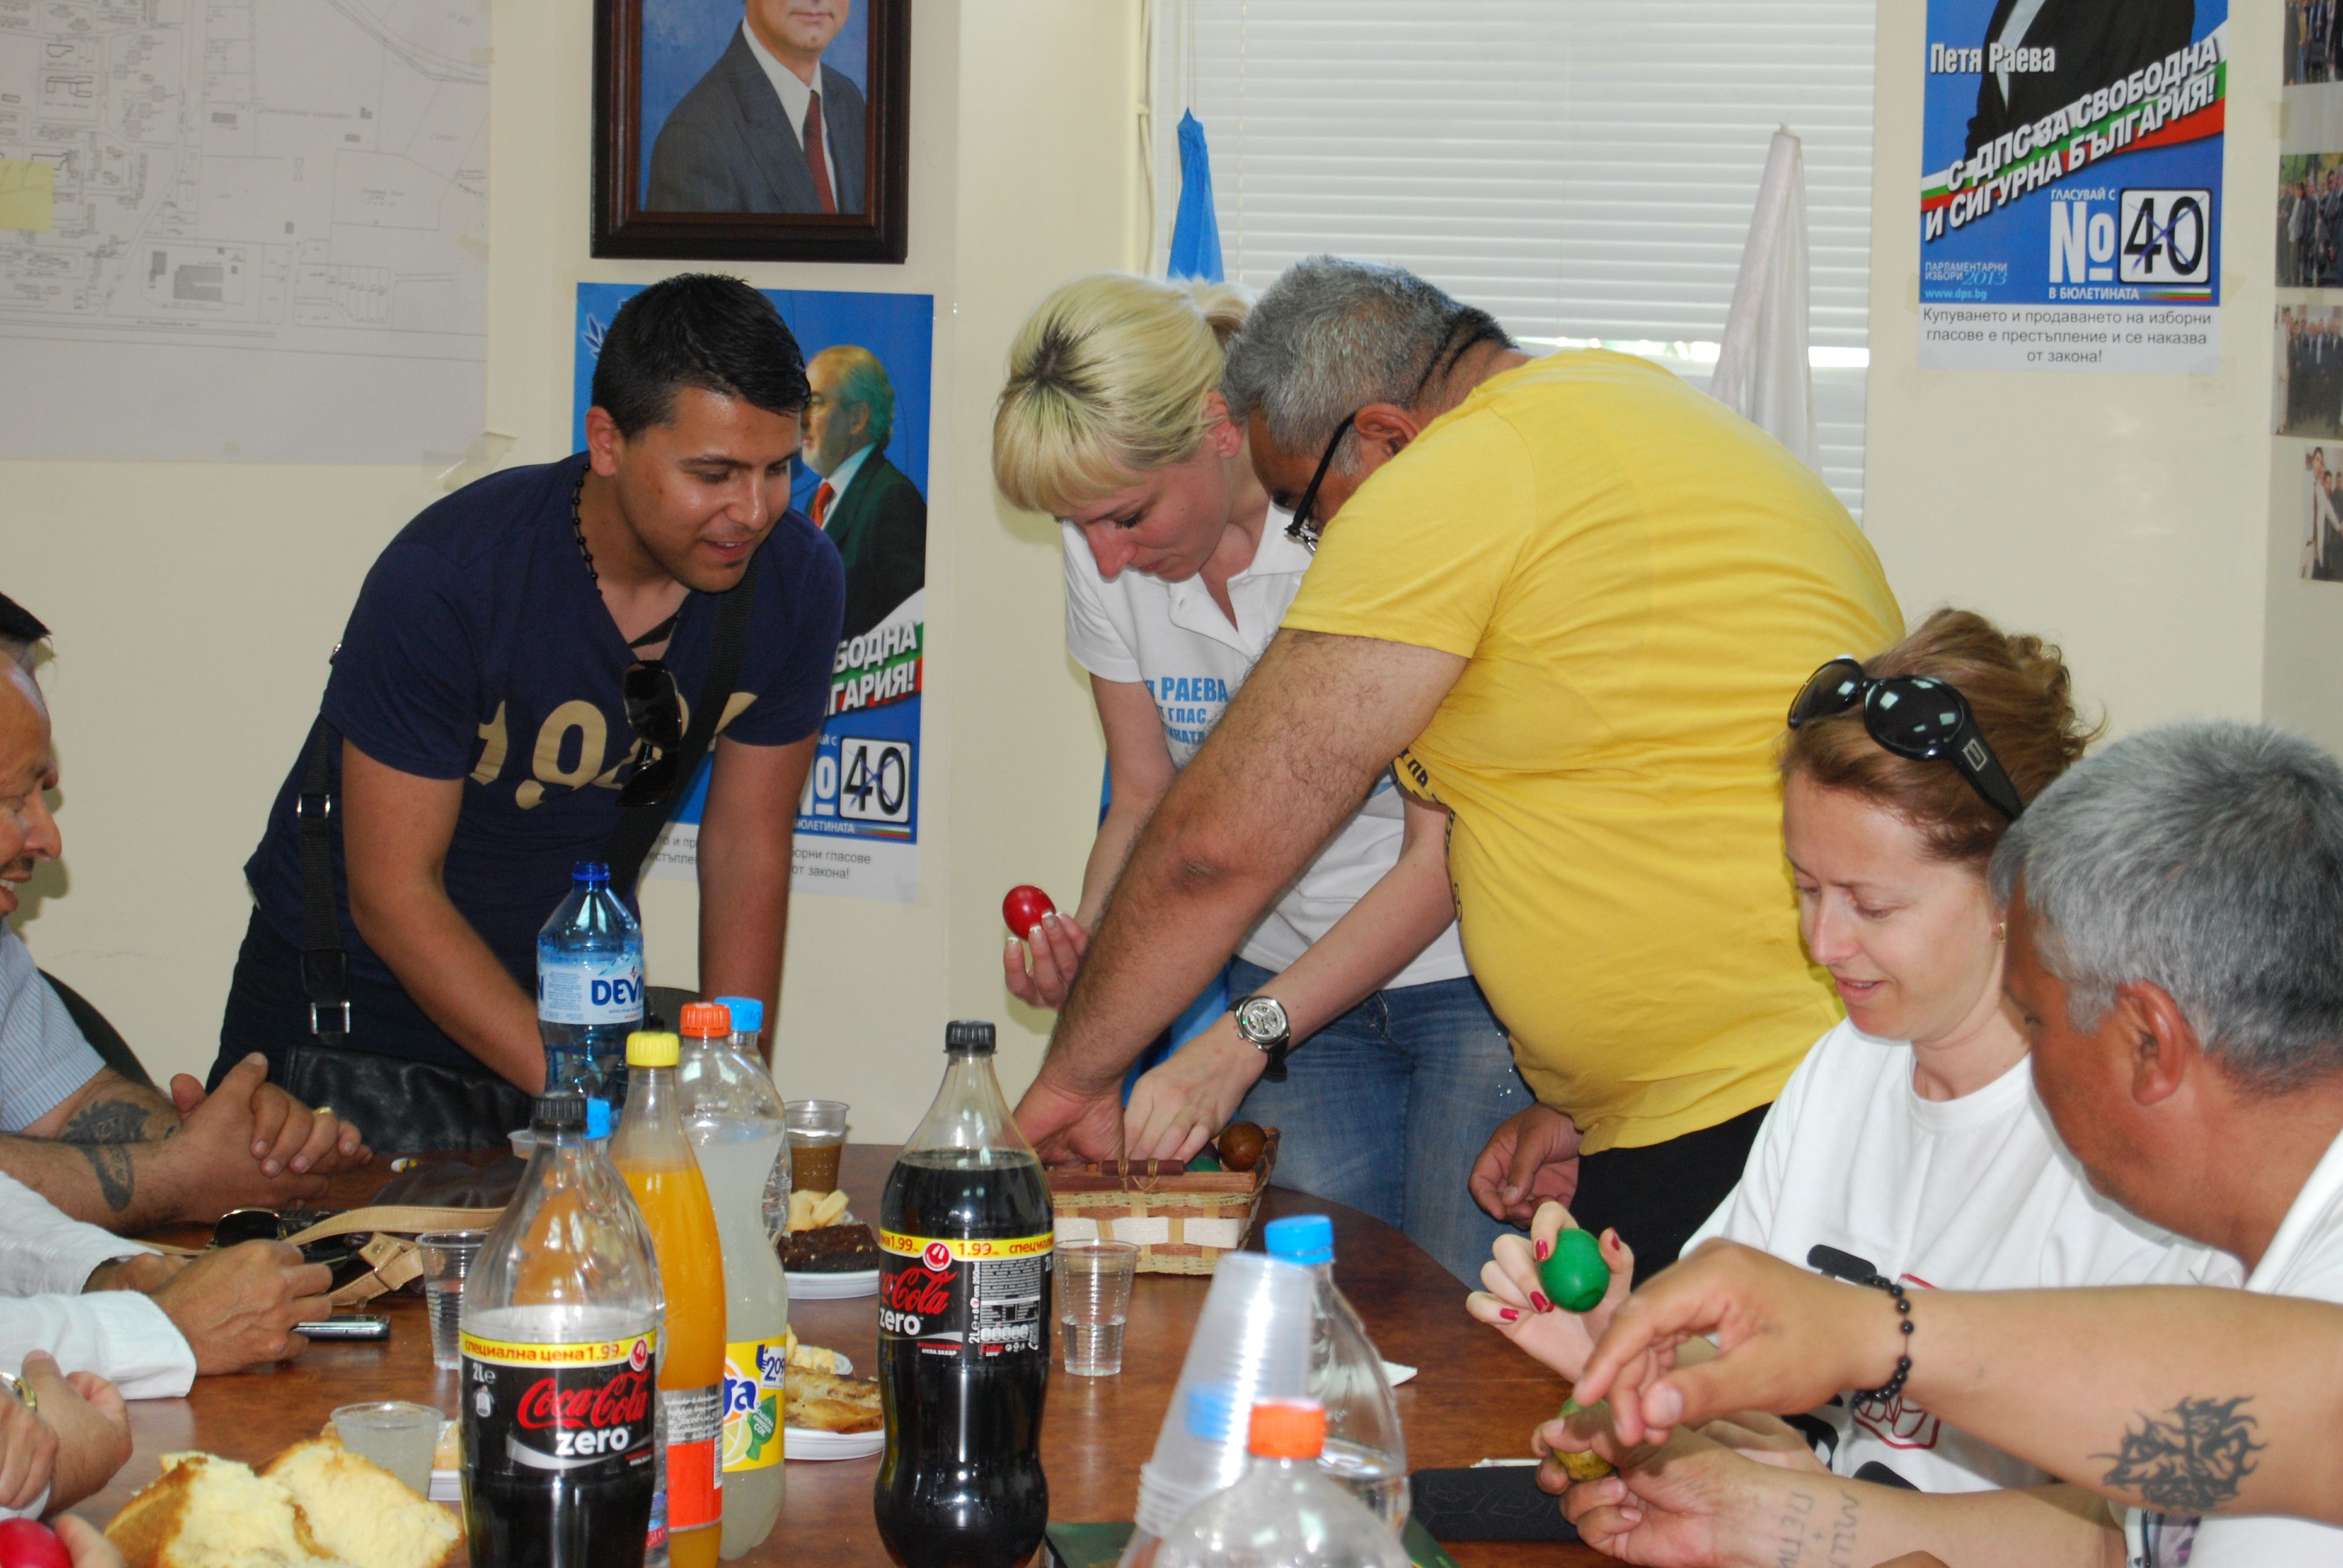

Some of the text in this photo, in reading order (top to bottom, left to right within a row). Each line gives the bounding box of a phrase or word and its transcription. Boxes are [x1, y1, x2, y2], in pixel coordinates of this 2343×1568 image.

[1930, 43, 2056, 73] Петя Раева
[1947, 37, 2219, 191] С ДПС ЗА СВОБОДНА
[1925, 73, 2215, 241] И СИГУРНА БЪЛГАРИЯ!
[2051, 188, 2105, 201] ГЛАСУВАЙ
[2123, 196, 2204, 276] 40
[1925, 262, 2007, 272] ПАРЛАМЕНТАРНИ
[1925, 271, 2007, 285] ИЗБОРИ 2013
[1925, 289, 1987, 301] www.dps.bg
[2049, 287, 2140, 301] В БЮЛЕТИНАТА
[1923, 308, 2211, 326] Купуването и продаването на изборни
[1927, 330, 2207, 345] гласове е престъпление и се наказва
[2027, 350, 2102, 363] от закона!
[833, 621, 917, 674] БОДНА
[825, 661, 914, 716] ГАРИЯ!
[1161, 677, 1229, 702] РАЕВА
[842, 745, 906, 816] 40
[826, 852, 871, 864] гласове
[808, 867, 850, 880] закона!
[891, 1236, 913, 1252] 1.99
[958, 1243, 992, 1256] 1.99
[879, 1307, 920, 1336] zero
[465, 1339, 620, 1363] специална цена 1.99
[555, 1427, 629, 1456] zero
